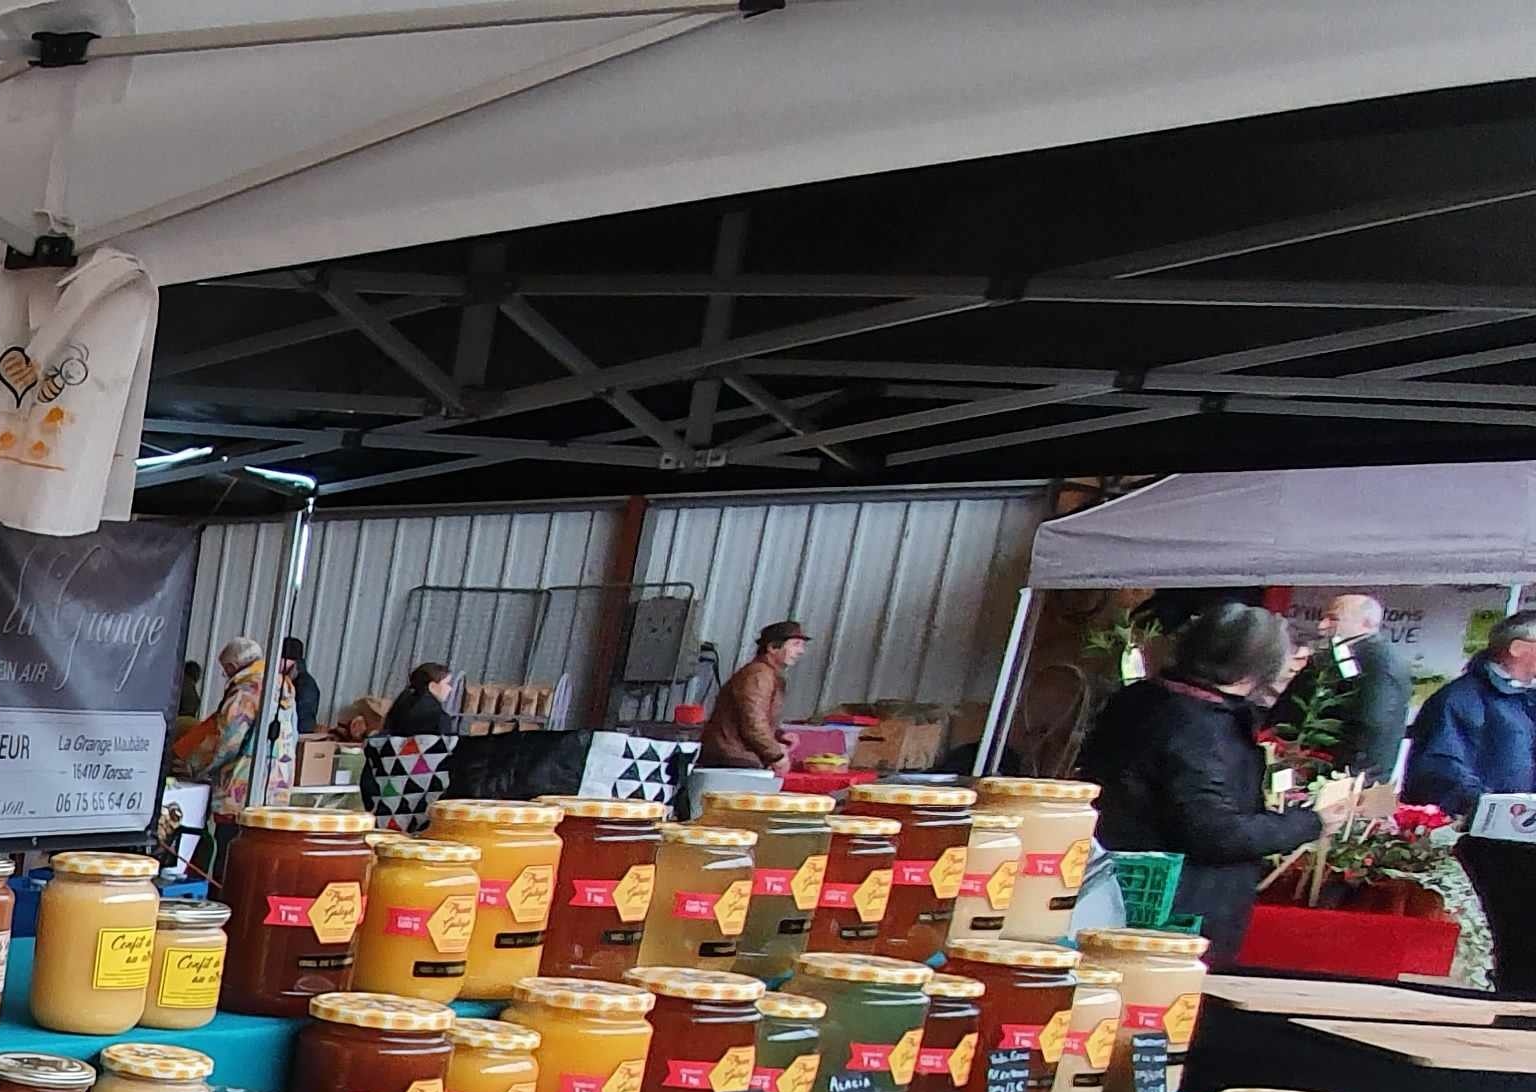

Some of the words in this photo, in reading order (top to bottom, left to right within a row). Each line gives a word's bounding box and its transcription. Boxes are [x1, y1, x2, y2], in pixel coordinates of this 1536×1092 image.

[18, 663, 48, 682] AIR
[58, 735, 72, 751] La
[73, 735, 112, 756] Grange
[103, 764, 133, 780] Torsac
[56, 793, 71, 813] 06
[76, 792, 88, 811] 75
[127, 792, 142, 810] 61
